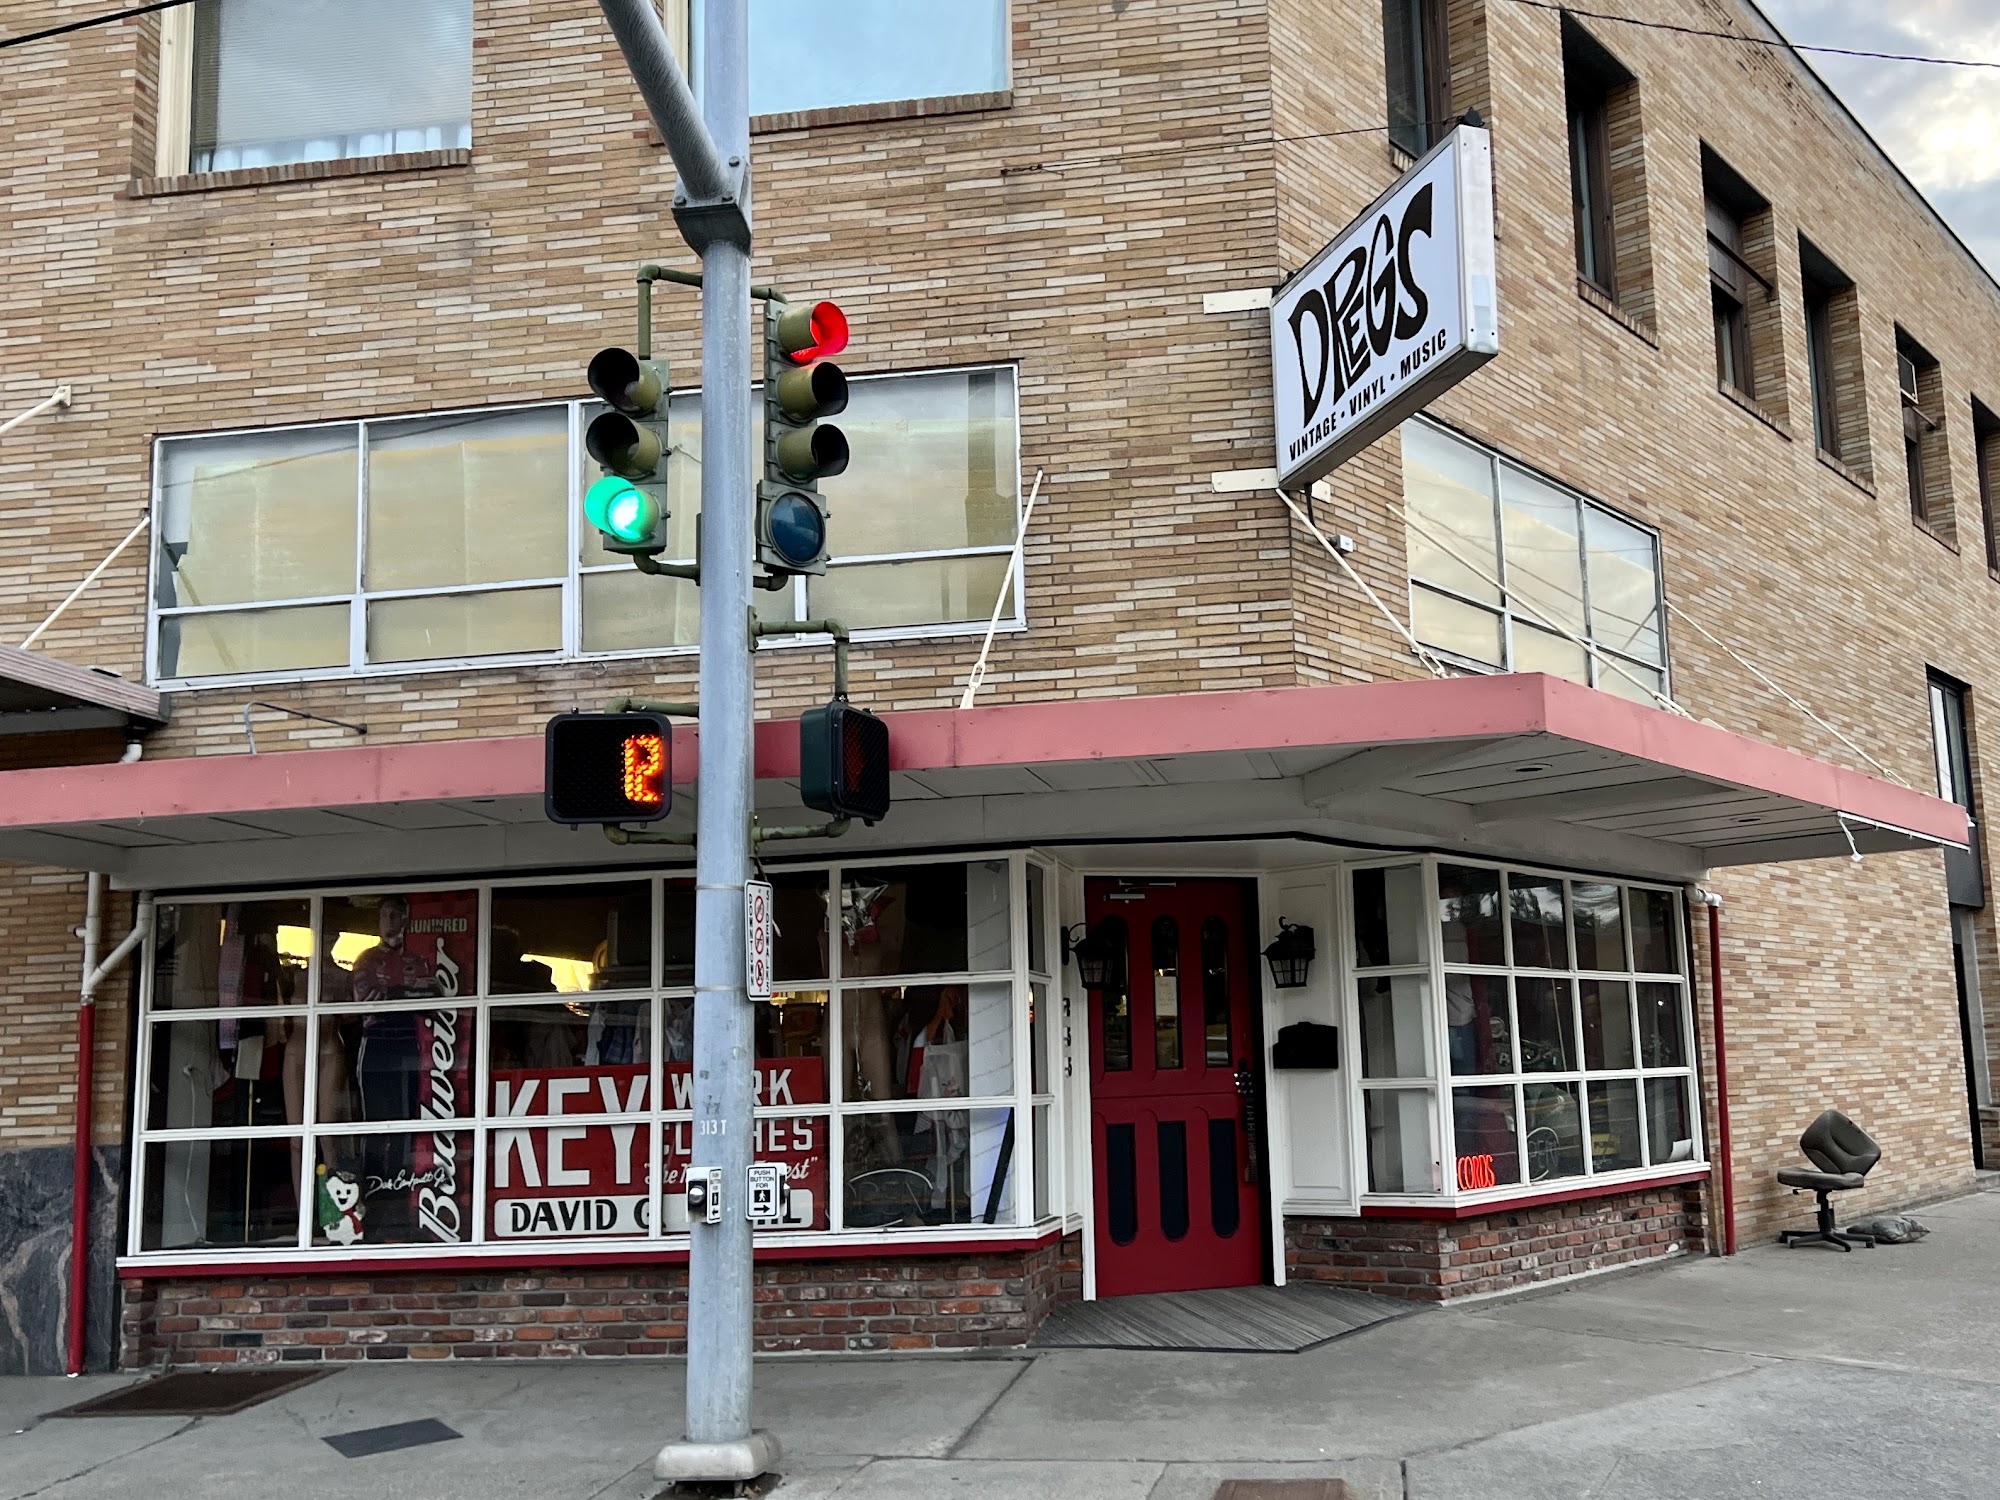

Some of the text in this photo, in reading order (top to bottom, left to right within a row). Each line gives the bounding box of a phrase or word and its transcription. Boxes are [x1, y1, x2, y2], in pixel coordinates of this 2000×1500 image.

[1288, 182, 1433, 428] DREGS
[1289, 328, 1448, 462] VINTAGE VINYL MUSIC
[443, 917, 468, 932] RED
[494, 1075, 649, 1188] KEY
[1456, 1154, 1496, 1190] CORDS
[510, 1198, 618, 1233] DAVID
